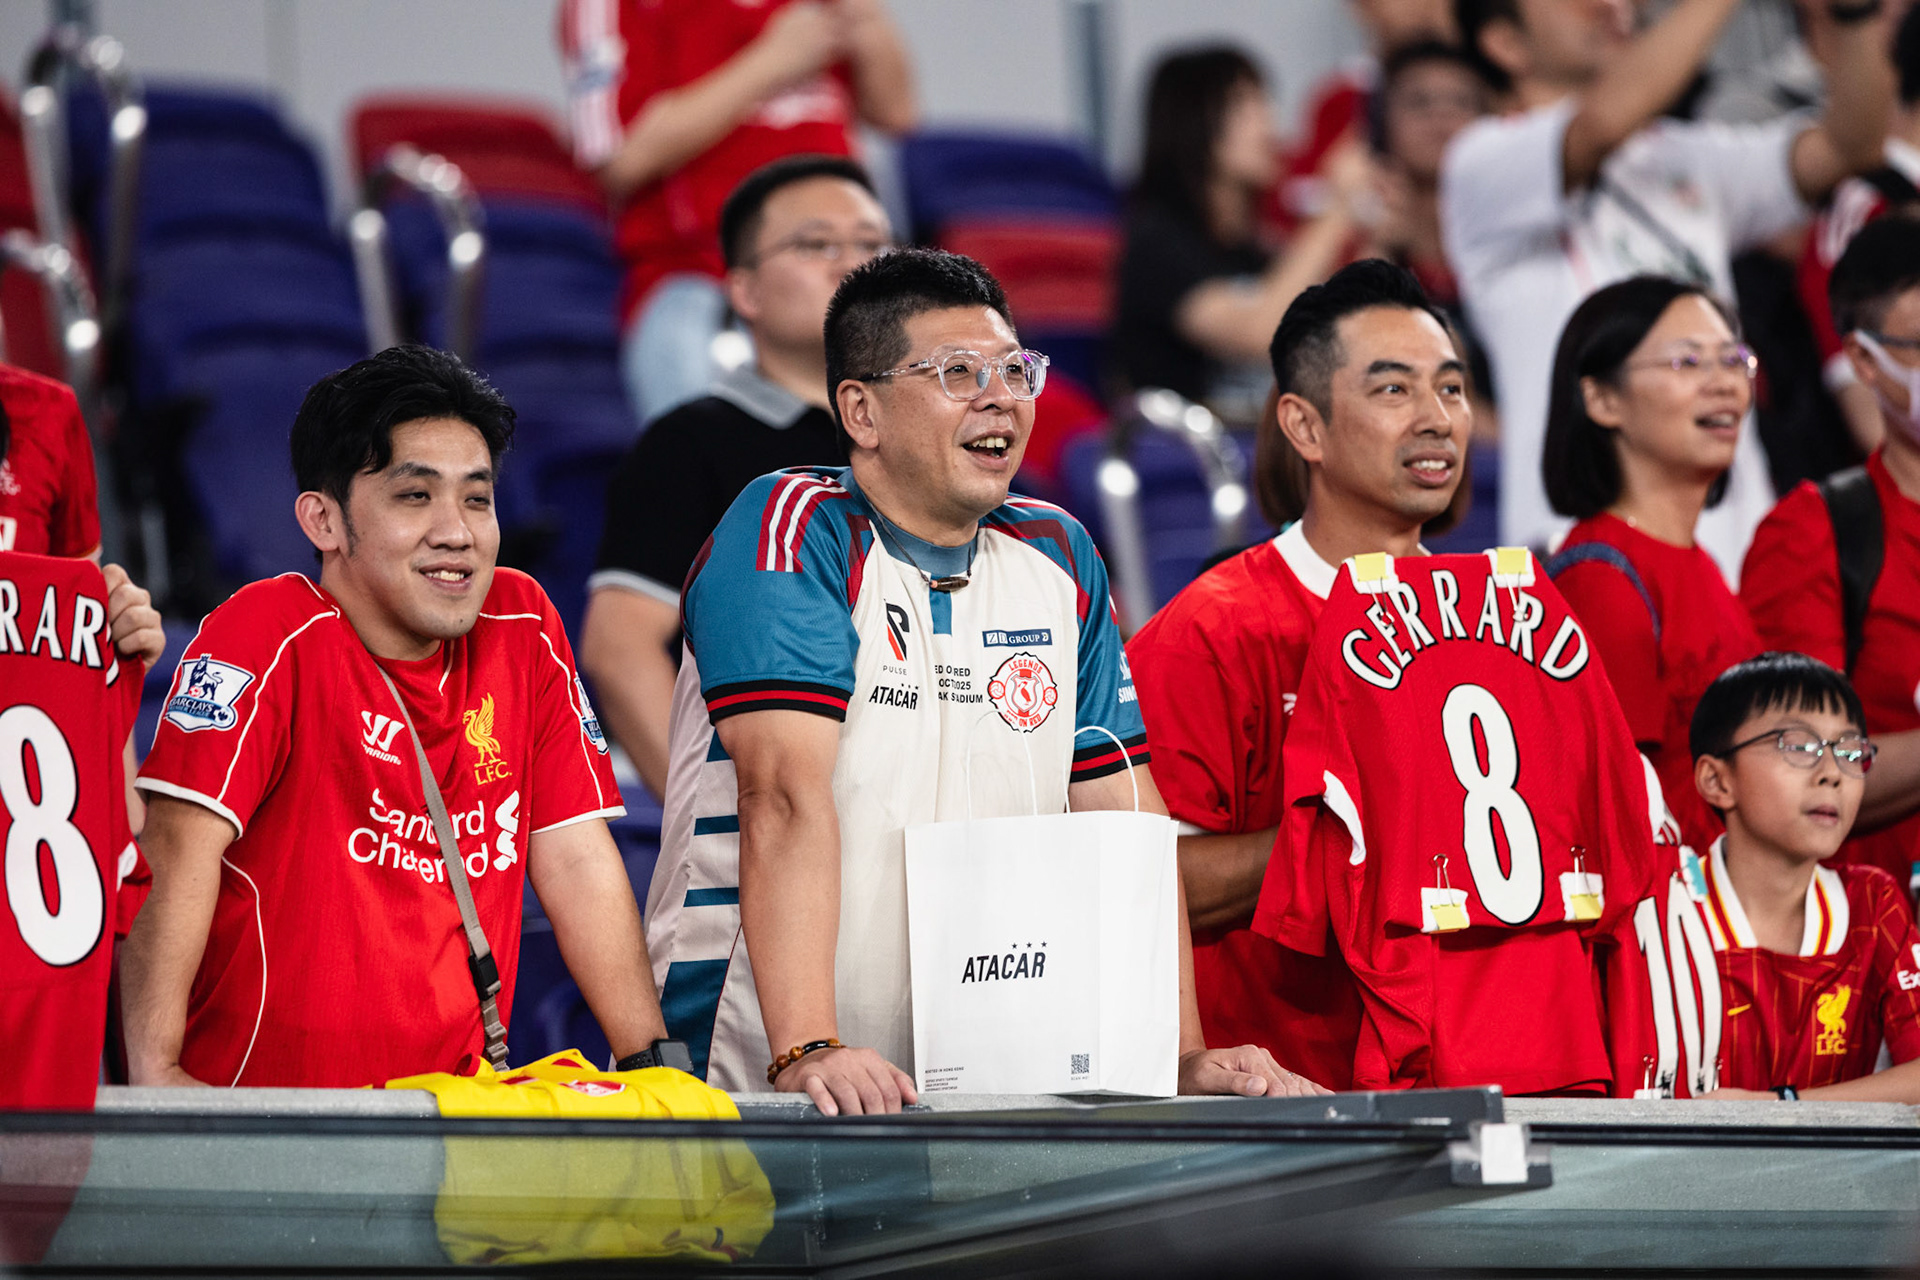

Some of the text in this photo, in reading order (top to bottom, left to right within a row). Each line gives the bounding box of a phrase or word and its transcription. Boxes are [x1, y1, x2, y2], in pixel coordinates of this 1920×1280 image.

[0, 579, 119, 686] RAR
[1008, 634, 1040, 644] GROUP
[1342, 570, 1590, 690] GERRARD
[883, 665, 907, 676] PULSE
[953, 668, 971, 677] RED
[1008, 659, 1043, 674] LEGENDS
[170, 697, 214, 712] BARCLAYS
[869, 686, 919, 710] ATACAR
[1442, 683, 1544, 926] 8
[0, 704, 104, 967] 8
[961, 952, 1046, 984] ATACAR
